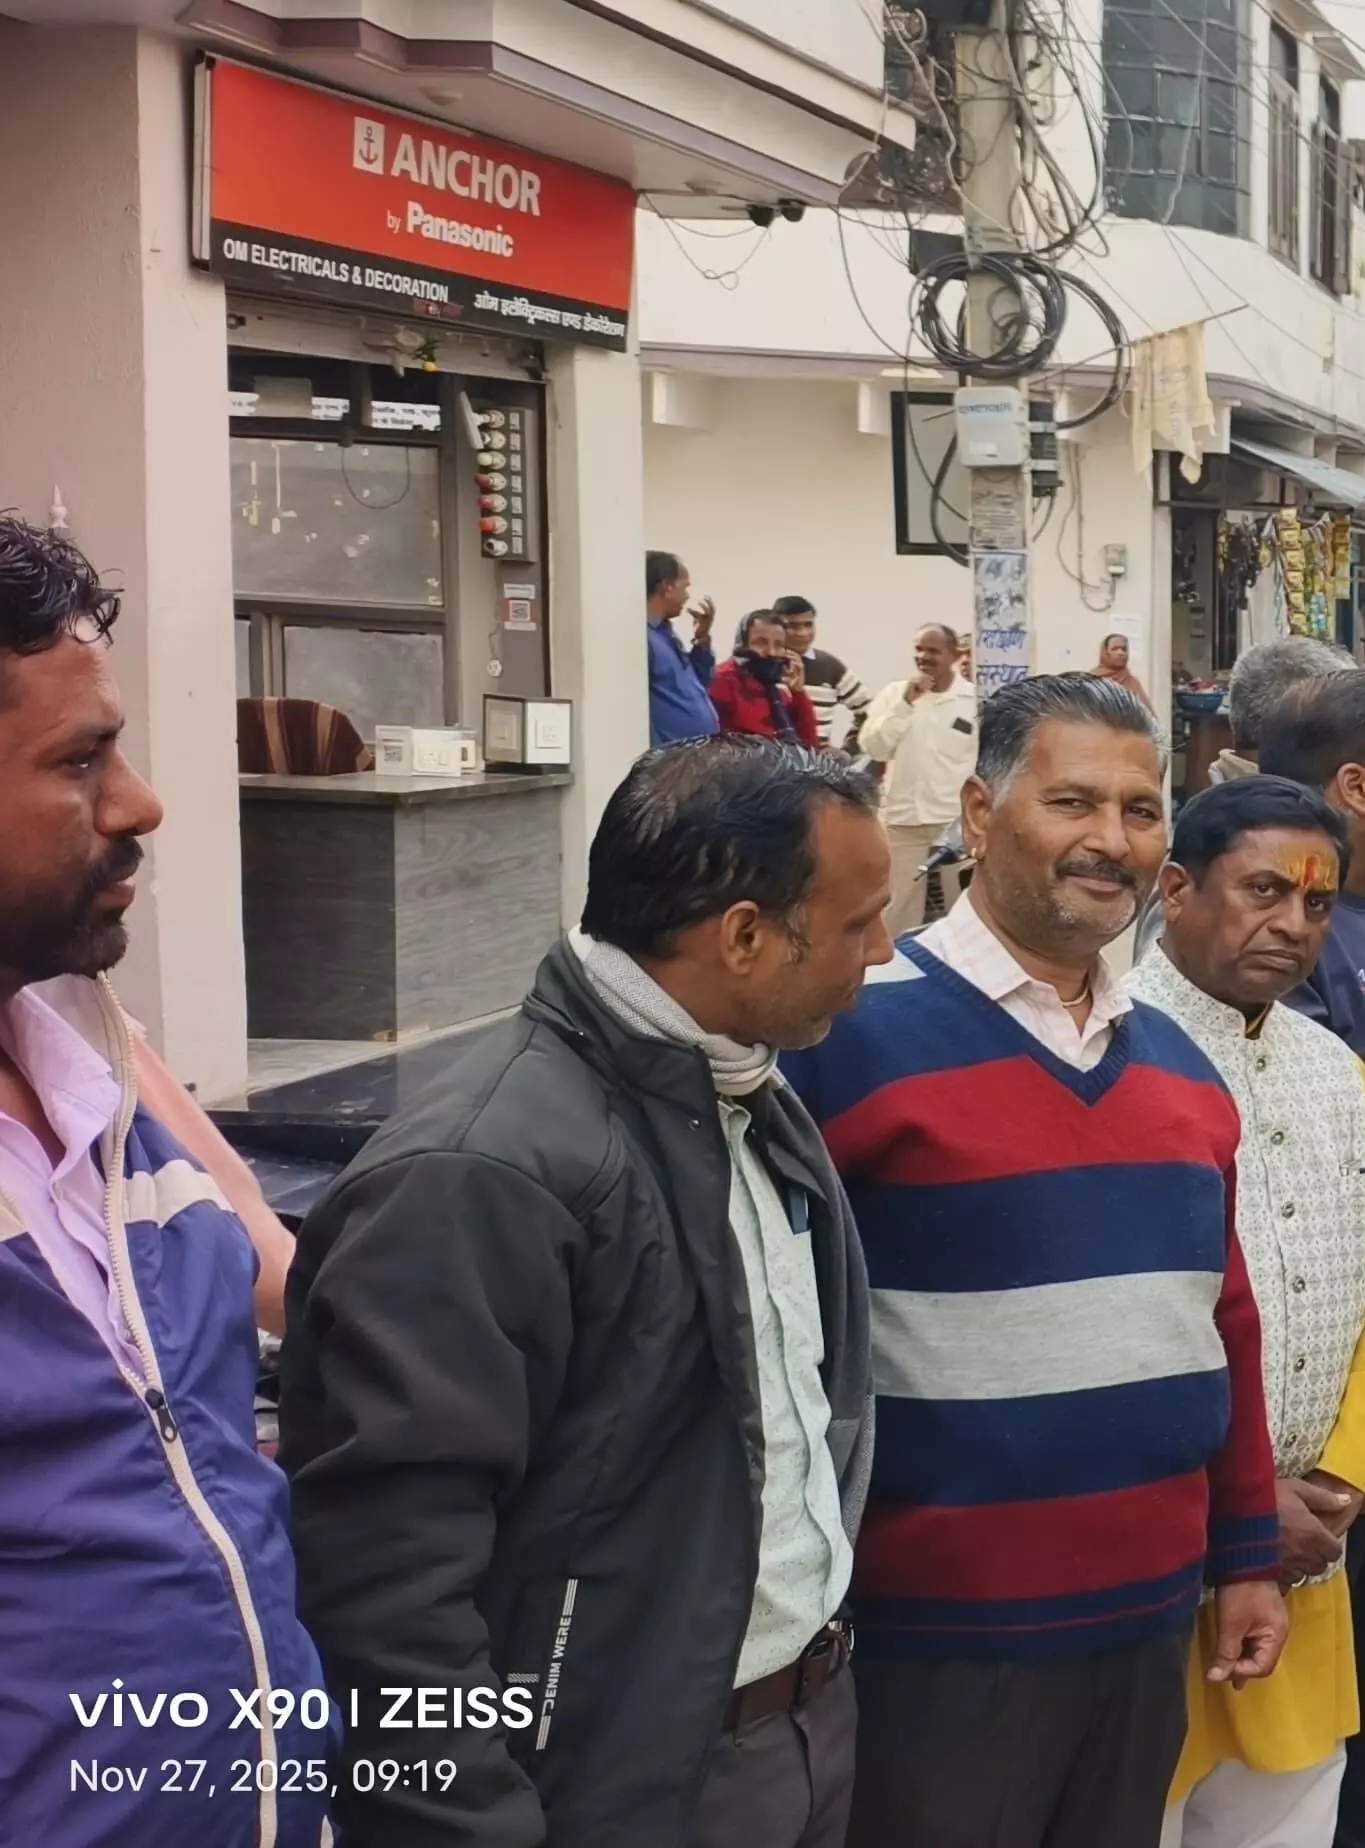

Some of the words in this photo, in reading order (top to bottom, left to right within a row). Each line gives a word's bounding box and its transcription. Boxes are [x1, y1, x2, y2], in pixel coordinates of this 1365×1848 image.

[391, 133, 541, 216] ANCHOR
[386, 210, 401, 234] by
[407, 200, 514, 257] Panasonic
[223, 238, 248, 262] OM
[251, 244, 350, 283] ELECTRICALS
[351, 265, 363, 285] &
[364, 268, 449, 303] DECORATION
[551, 1616, 572, 1660] WERE
